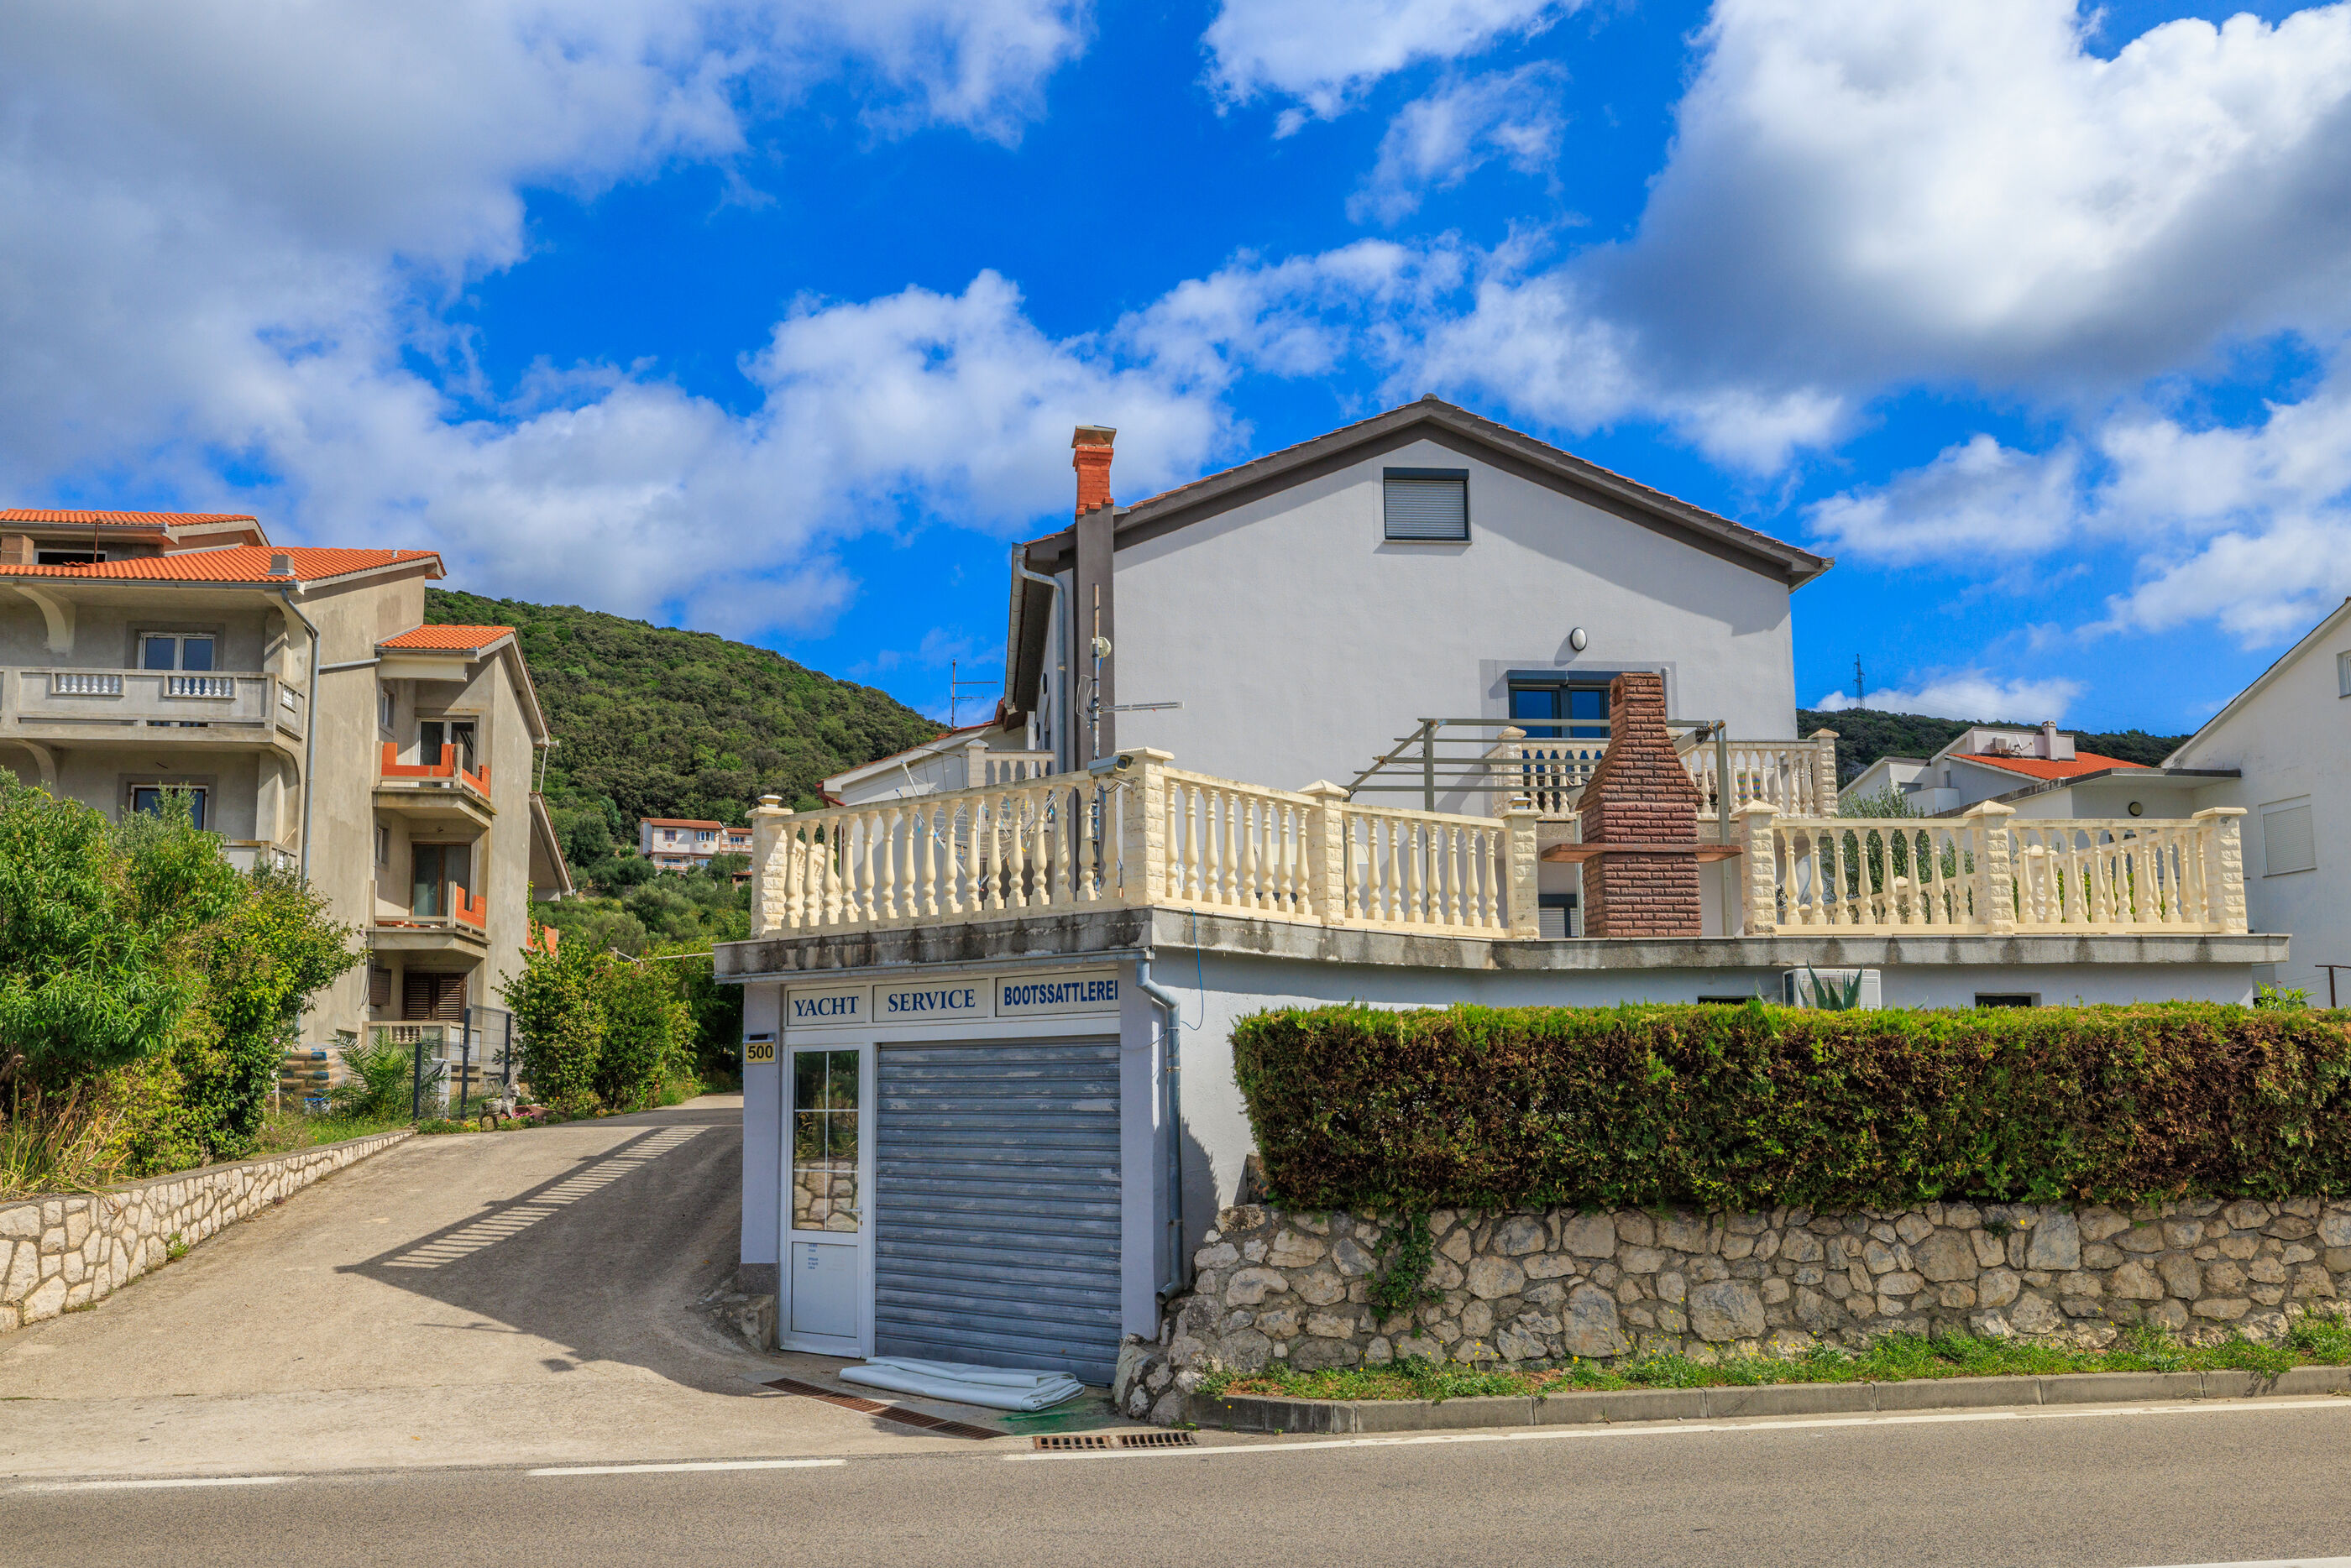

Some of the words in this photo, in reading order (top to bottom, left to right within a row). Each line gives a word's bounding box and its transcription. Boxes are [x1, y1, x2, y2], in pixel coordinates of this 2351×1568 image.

[794, 996, 859, 1017] YACHT
[888, 989, 976, 1012] SERVICE
[1004, 980, 1118, 1006] BOOTSSATTLEREI
[748, 1045, 772, 1058] 500
